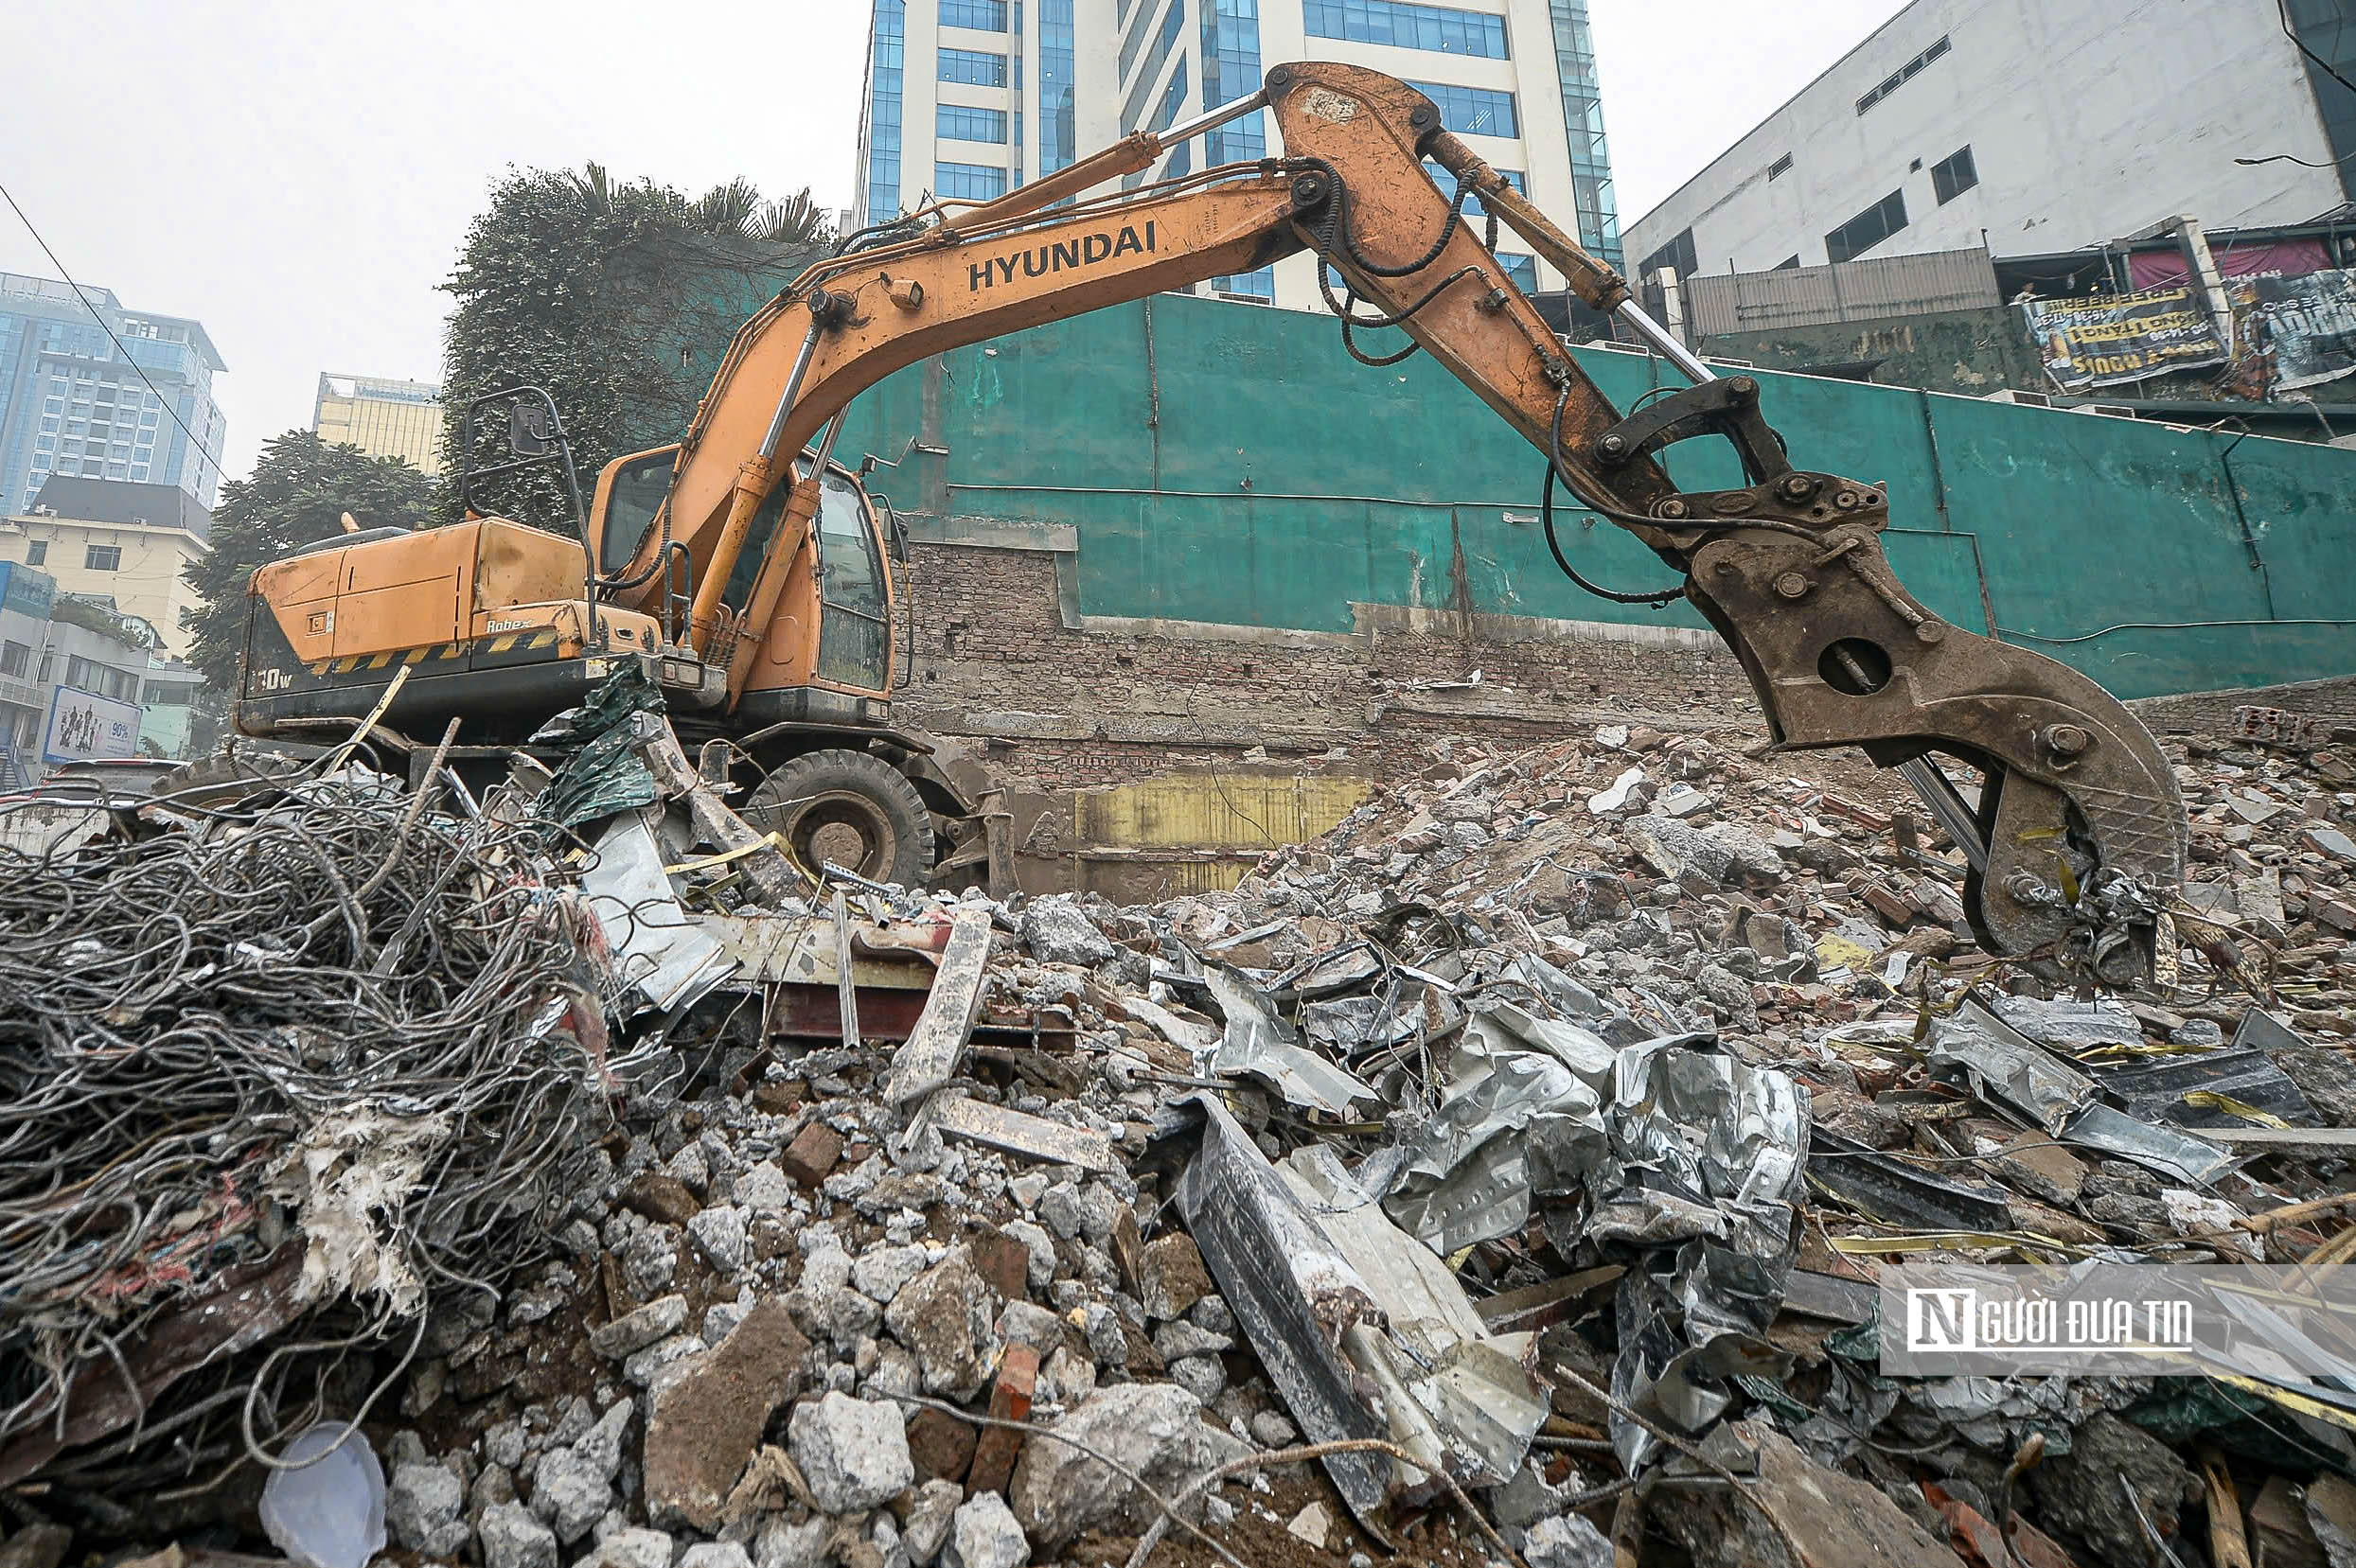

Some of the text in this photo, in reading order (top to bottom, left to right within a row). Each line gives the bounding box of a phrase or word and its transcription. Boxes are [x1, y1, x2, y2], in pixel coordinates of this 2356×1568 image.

[970, 220, 1156, 291] HYUNDAI
[487, 618, 532, 633] Robex
[112, 721, 129, 739] 90%
